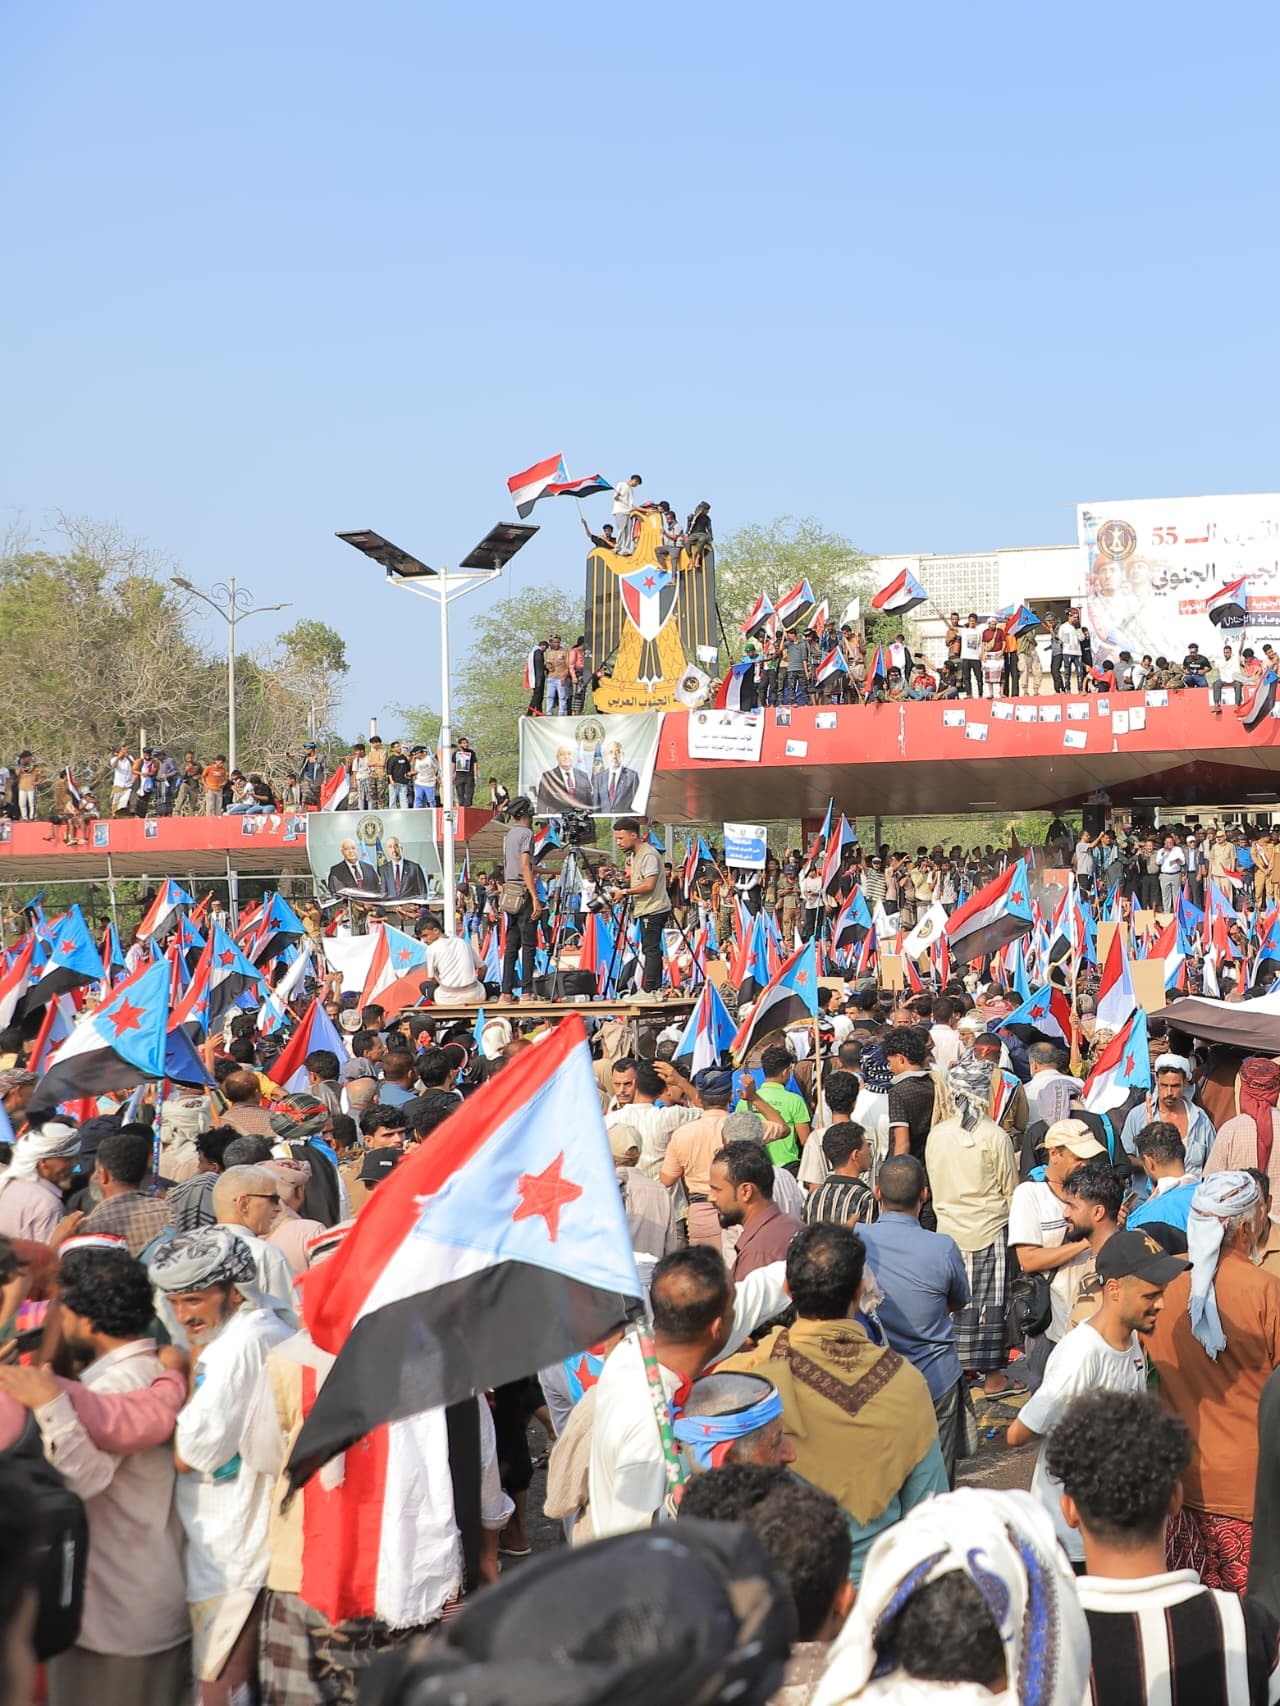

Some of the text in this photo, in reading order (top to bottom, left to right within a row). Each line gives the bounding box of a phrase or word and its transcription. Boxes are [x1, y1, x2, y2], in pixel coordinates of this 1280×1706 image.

[1152, 526, 1179, 546] 55
[1151, 562, 1217, 598] الجنوبي
[608, 695, 637, 708] العربي
[639, 695, 671, 710] الجنوب
